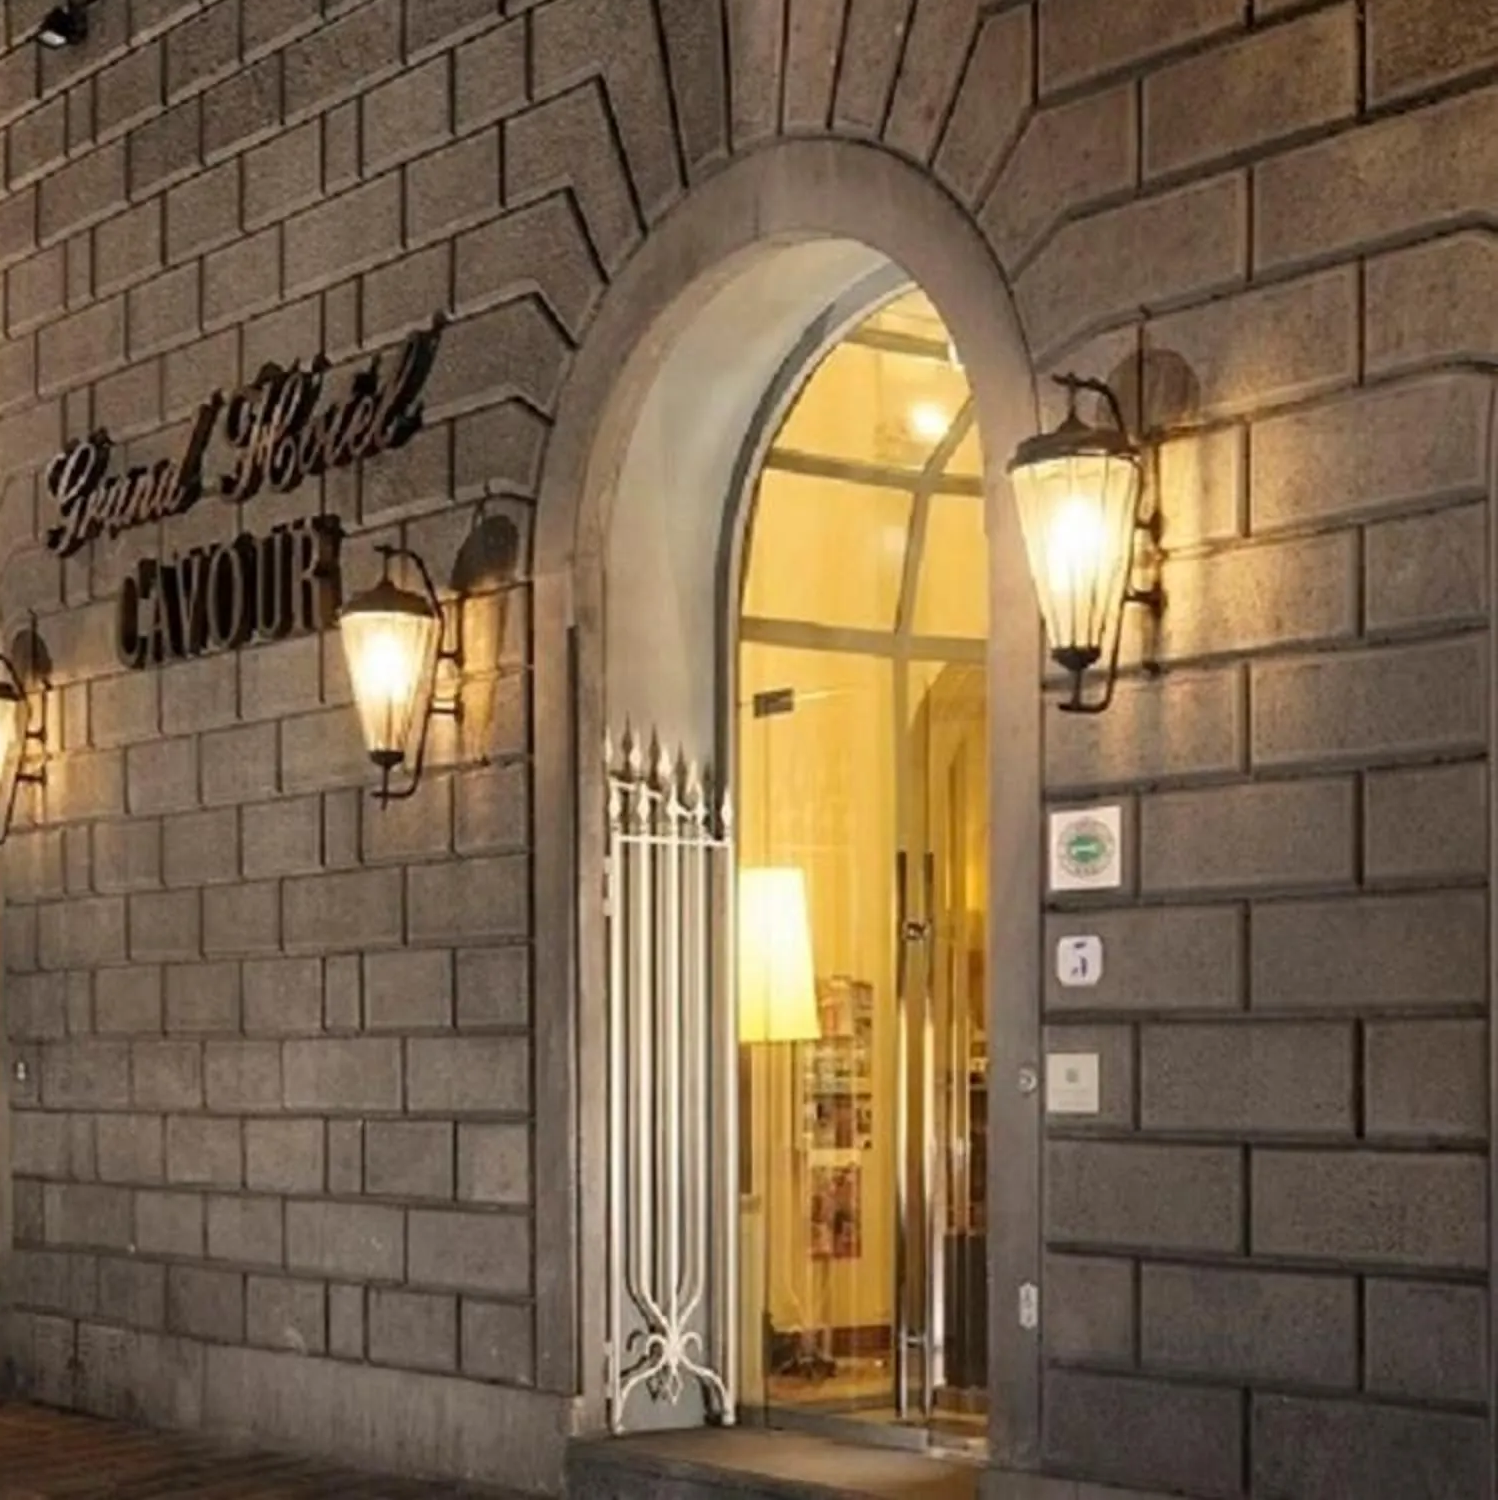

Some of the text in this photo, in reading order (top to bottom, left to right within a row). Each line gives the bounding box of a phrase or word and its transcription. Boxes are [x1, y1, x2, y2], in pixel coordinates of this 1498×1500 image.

[47, 312, 444, 557] Grand Hotel
[118, 515, 341, 668] CAVOUR
